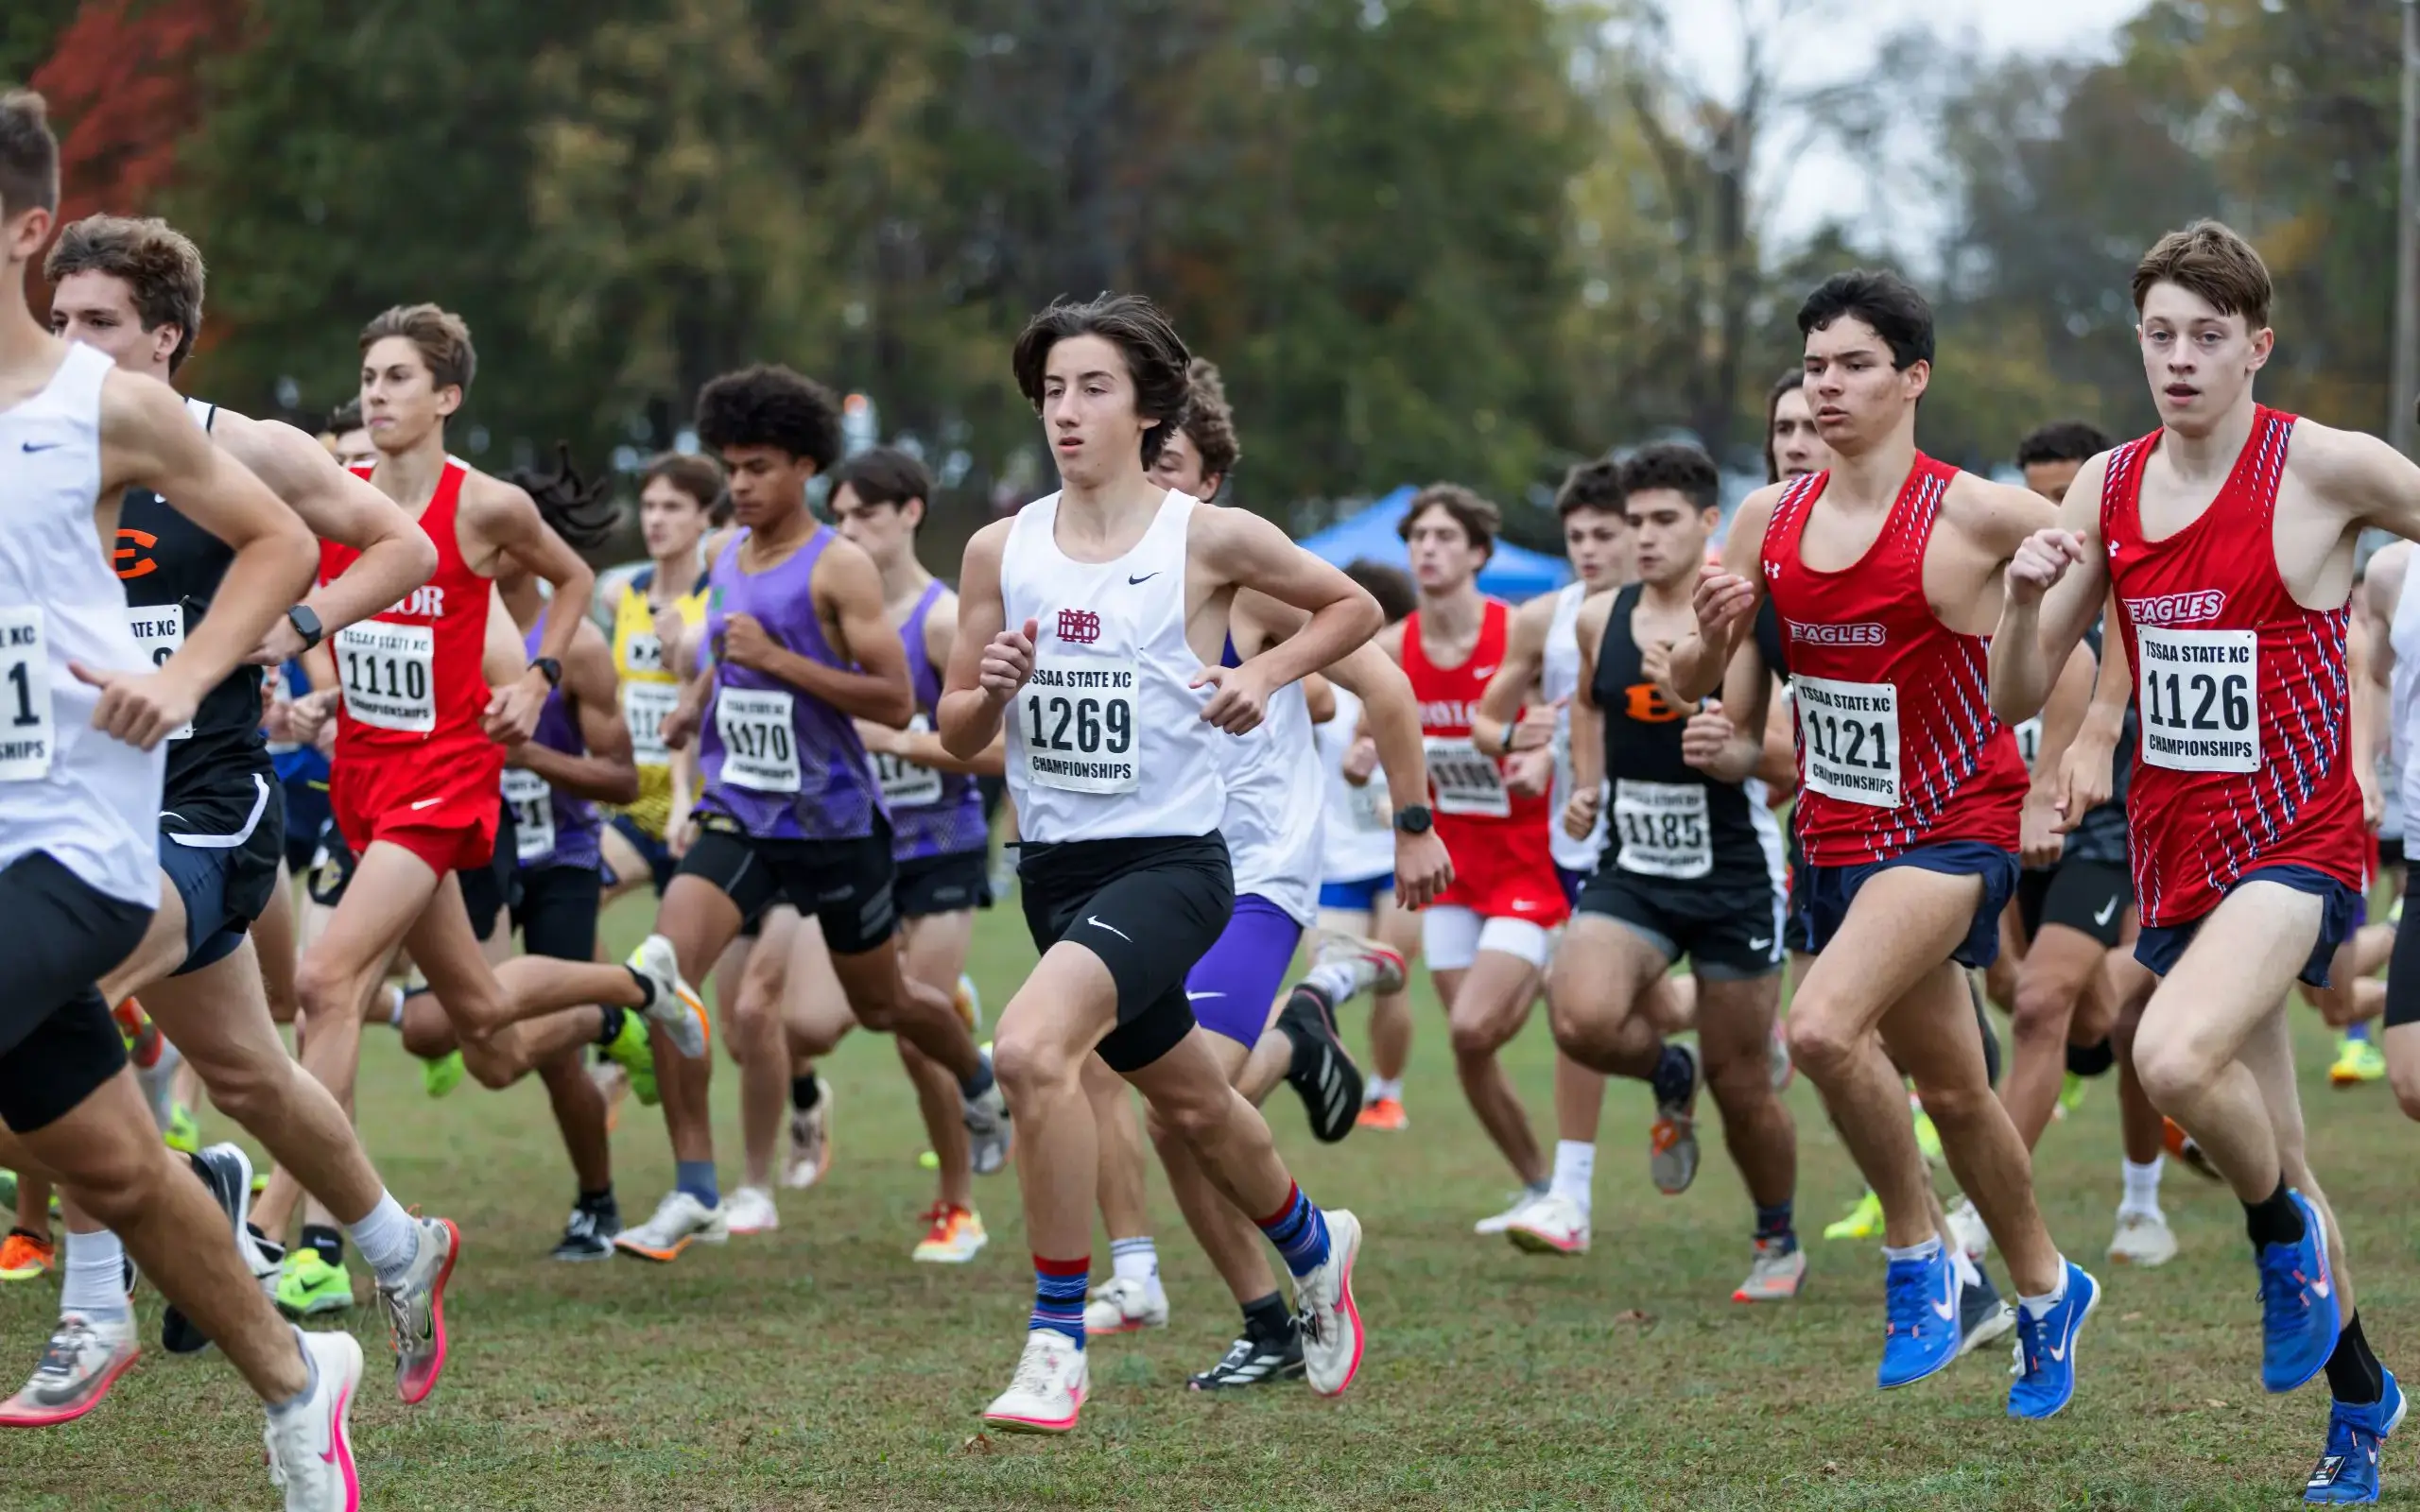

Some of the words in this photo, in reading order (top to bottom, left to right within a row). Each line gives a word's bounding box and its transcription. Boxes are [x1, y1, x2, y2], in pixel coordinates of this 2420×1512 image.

[2131, 591, 2221, 623] EAGLES
[10, 626, 36, 645] XC
[156, 619, 176, 636] XC
[1791, 623, 1880, 642] EAGLES
[2145, 640, 2178, 662] TSSAA
[2182, 645, 2225, 663] STATE
[2228, 645, 2249, 663] XC
[348, 651, 425, 700] 1110
[1028, 668, 1064, 687] SSAA
[1066, 671, 1109, 688] STATE
[1112, 671, 1132, 688] XC
[1800, 685, 1832, 707] TSSAA
[1835, 694, 1869, 711] STATE
[1872, 697, 1891, 713] XC
[2148, 669, 2249, 730] 1126
[1028, 695, 1131, 754] 1269
[727, 721, 789, 762] 1170
[1808, 710, 1892, 770] 1121
[2149, 733, 2253, 758] CHAMPIONSHIPS
[1032, 755, 1132, 779] CHAMPIONSHIPS
[1812, 763, 1893, 795] CHAMPIONSHIPS
[1625, 812, 1701, 849] 1185
